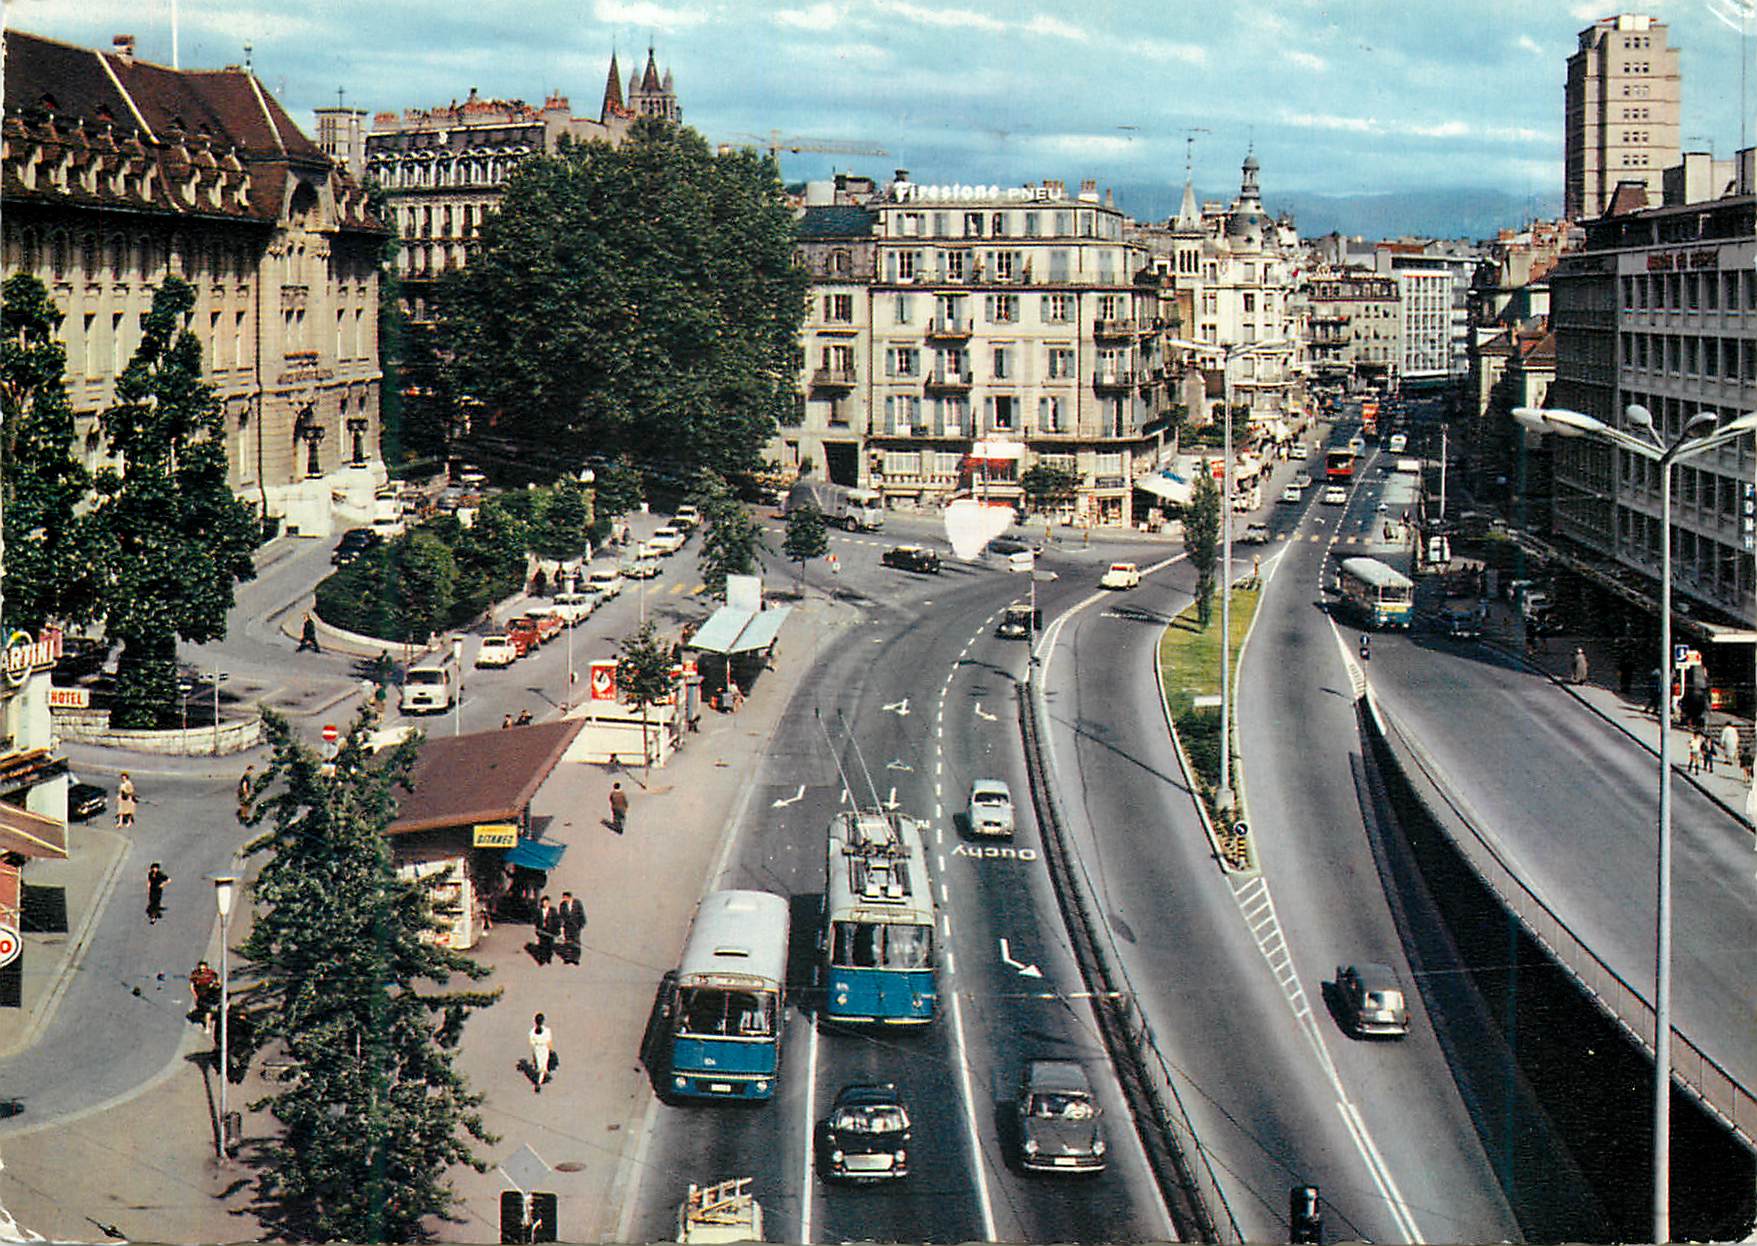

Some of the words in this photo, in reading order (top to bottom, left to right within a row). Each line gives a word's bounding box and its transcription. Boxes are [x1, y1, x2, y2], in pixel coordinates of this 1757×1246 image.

[893, 181, 1000, 202] Firestone
[50, 690, 82, 705] HOTEL
[951, 843, 1037, 861] Ouchy
